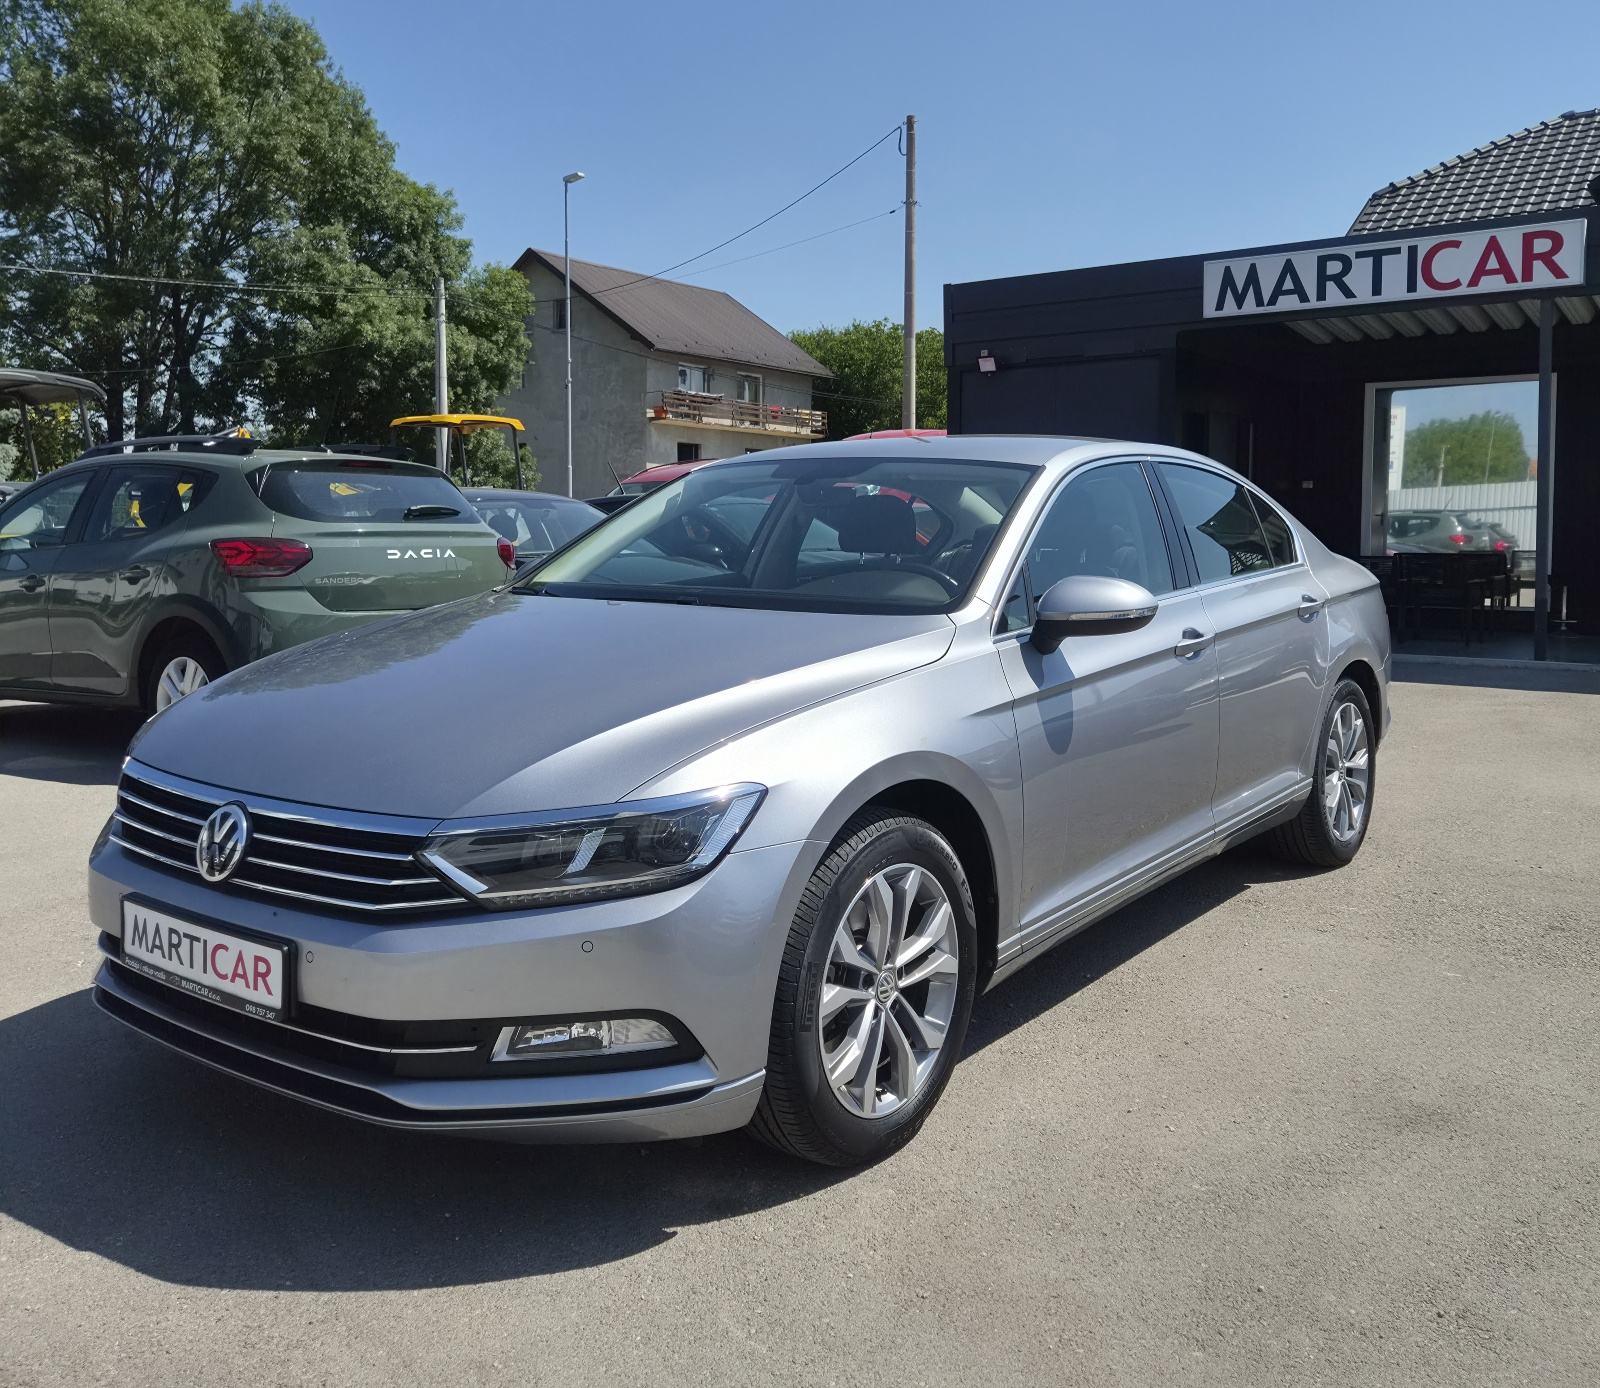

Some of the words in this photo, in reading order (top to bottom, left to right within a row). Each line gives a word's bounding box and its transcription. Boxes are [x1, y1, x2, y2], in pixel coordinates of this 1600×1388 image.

[1214, 229, 1569, 312] MARTICAR
[387, 548, 456, 559] DACIA
[131, 914, 274, 996] MARTICAR
[181, 979, 208, 997] MARTICAR
